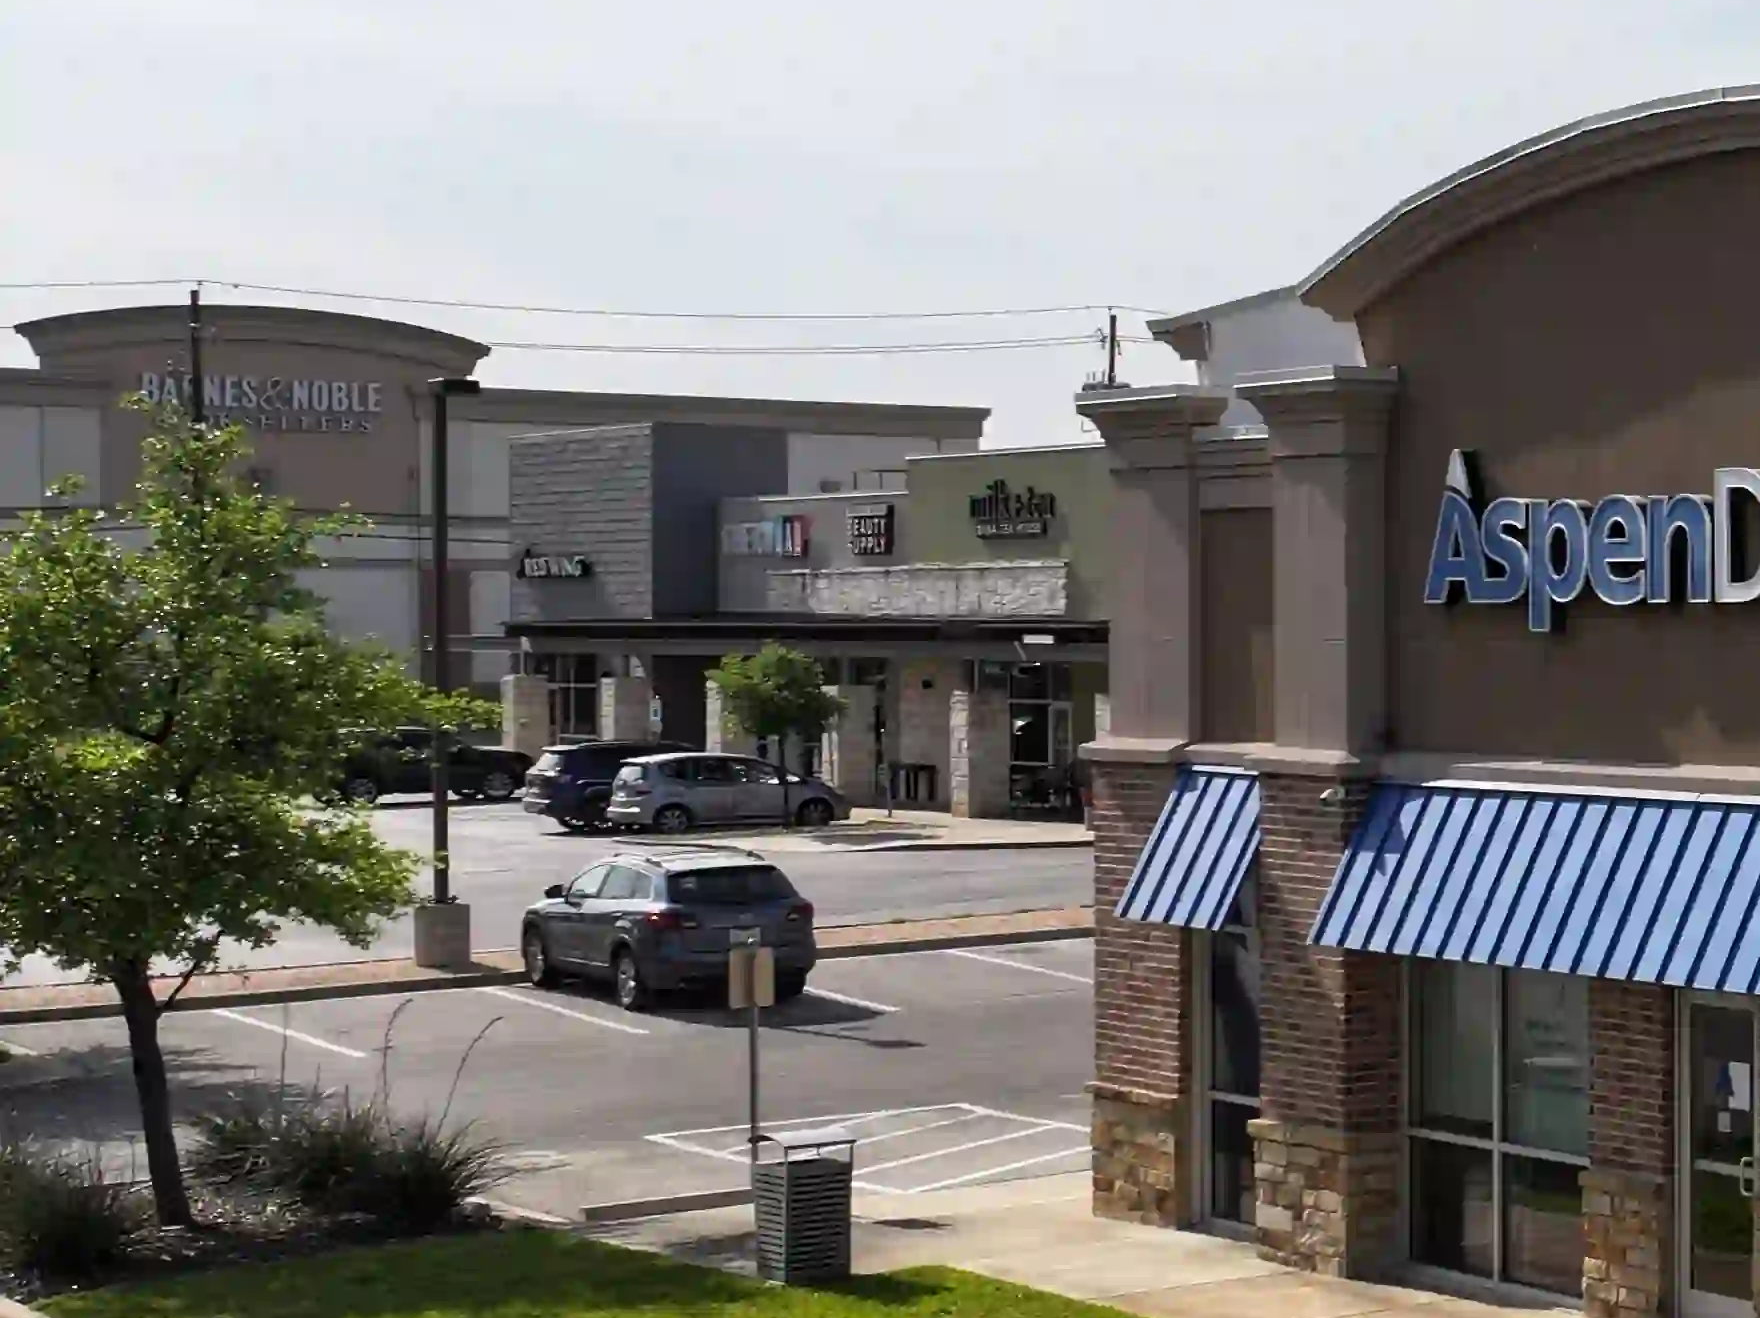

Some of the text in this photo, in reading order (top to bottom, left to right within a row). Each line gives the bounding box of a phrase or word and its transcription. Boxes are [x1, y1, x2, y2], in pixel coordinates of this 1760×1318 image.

[140, 372, 383, 412] BANES & NOBLE
